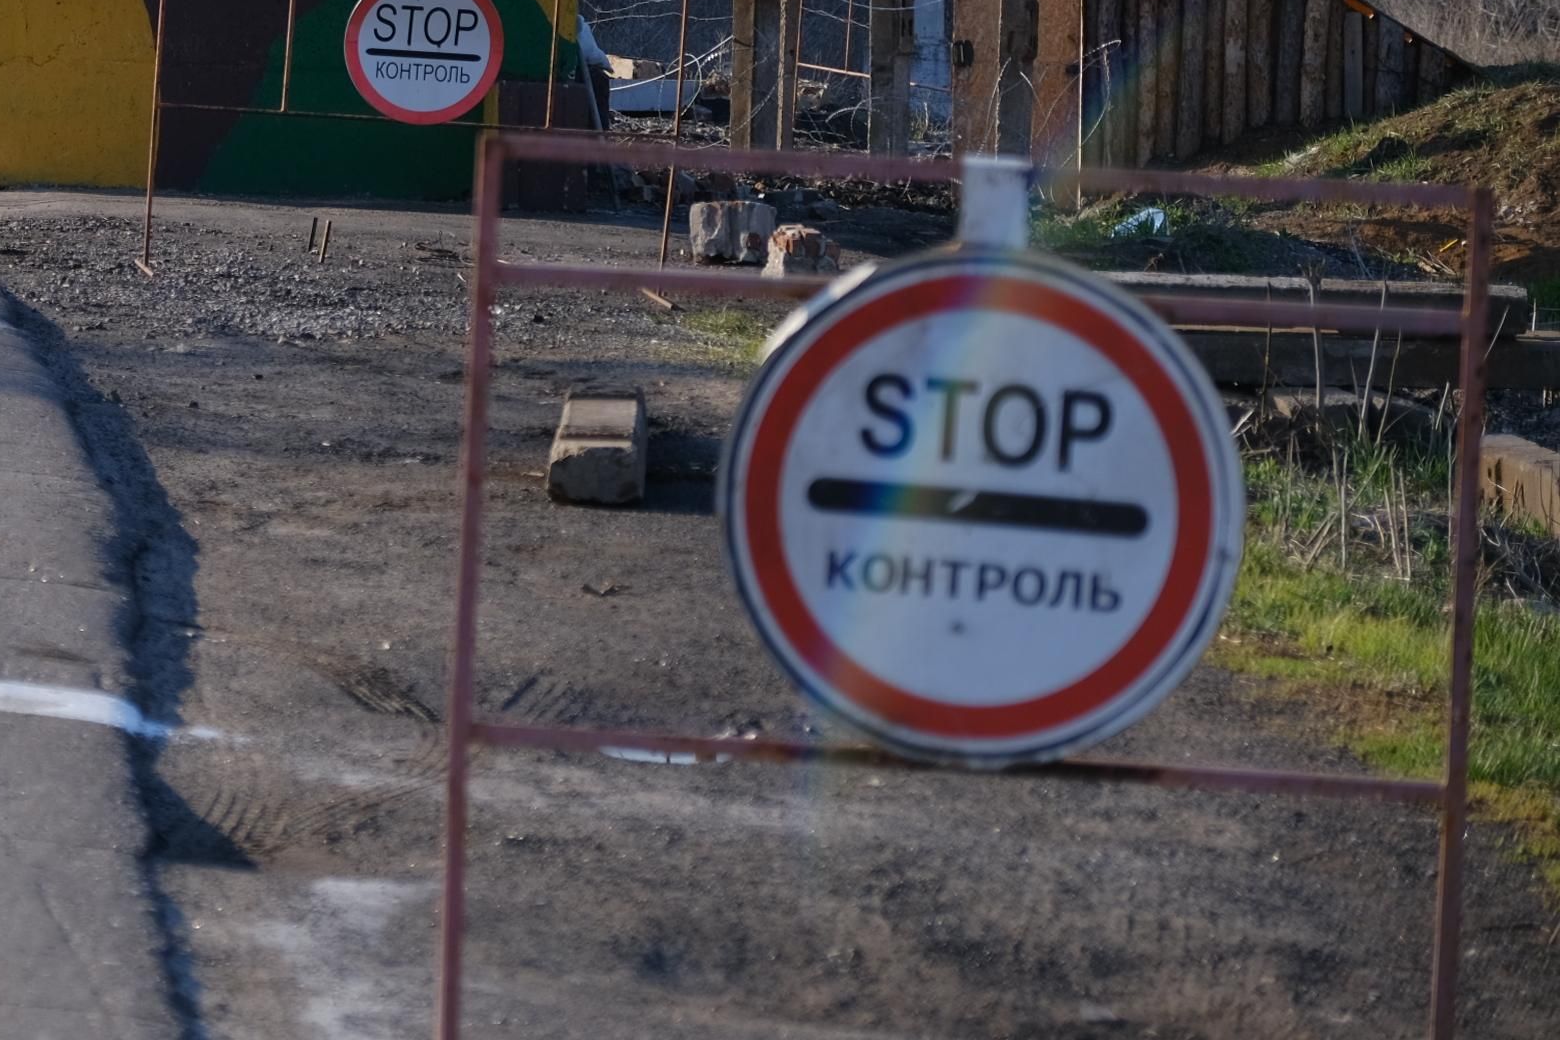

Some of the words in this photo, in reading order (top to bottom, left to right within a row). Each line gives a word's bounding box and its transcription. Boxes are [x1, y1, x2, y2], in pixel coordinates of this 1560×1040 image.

[373, 3, 479, 48] STOP
[375, 61, 471, 84] КОНТРОЛЬ
[860, 373, 1115, 473] STOP
[826, 550, 1124, 613] КОНТРОЛЬ
